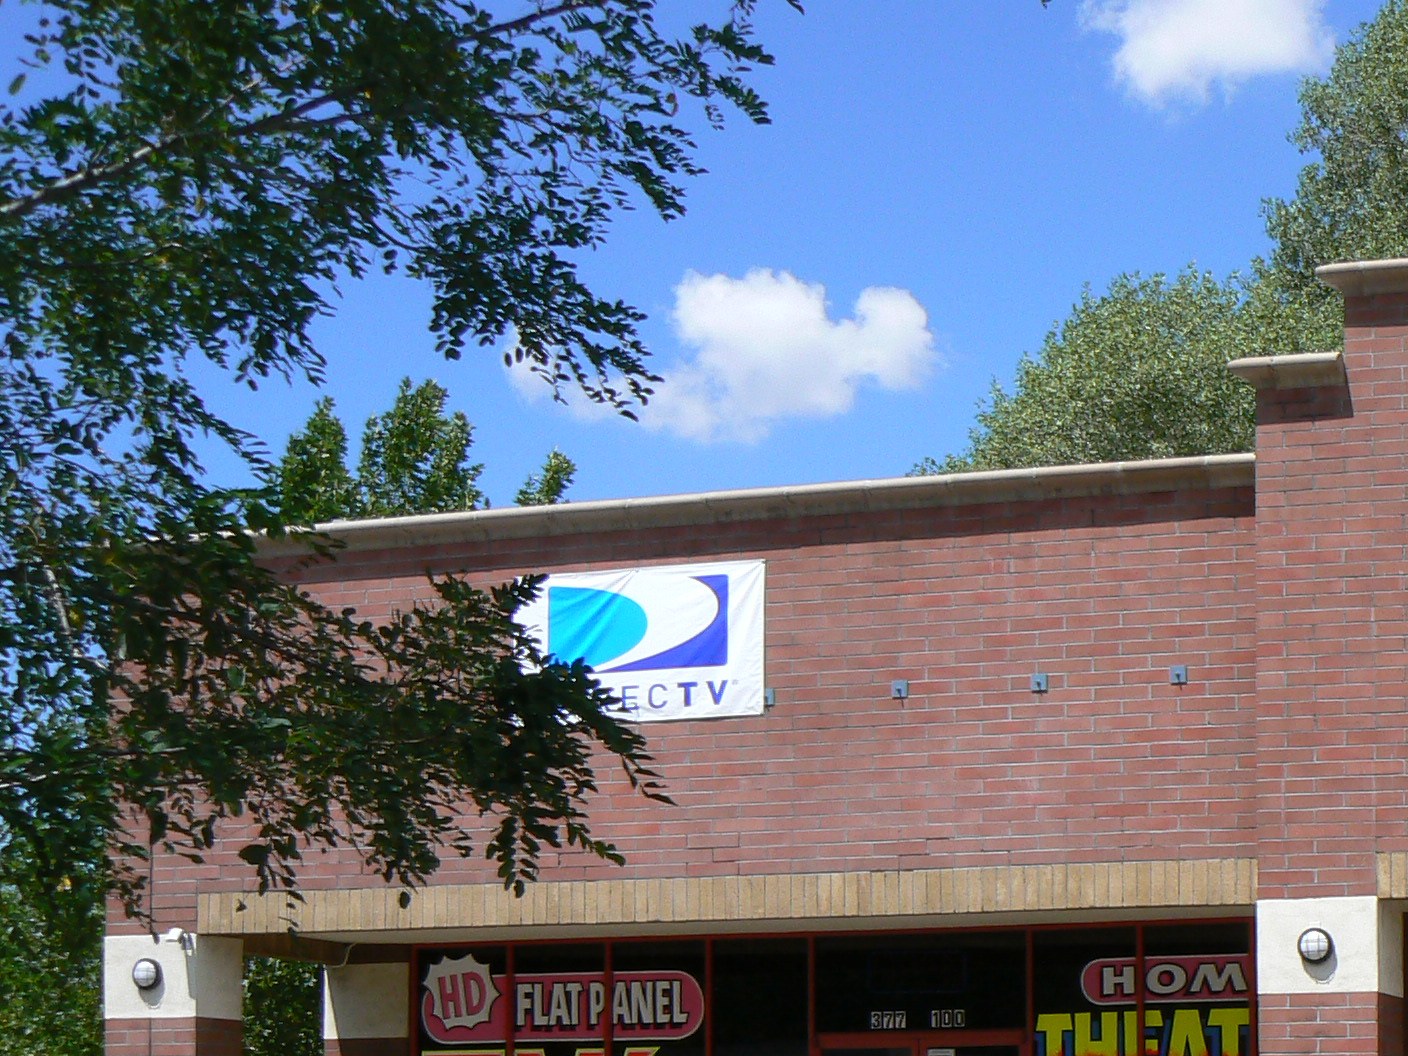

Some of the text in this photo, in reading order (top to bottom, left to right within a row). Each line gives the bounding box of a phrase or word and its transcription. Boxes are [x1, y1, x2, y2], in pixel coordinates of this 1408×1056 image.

[1101, 962, 1248, 996] HOM
[436, 969, 488, 1025] HD
[515, 979, 689, 1027] FLAT PANEL
[871, 1011, 906, 1029] 377
[931, 1009, 965, 1028] 100
